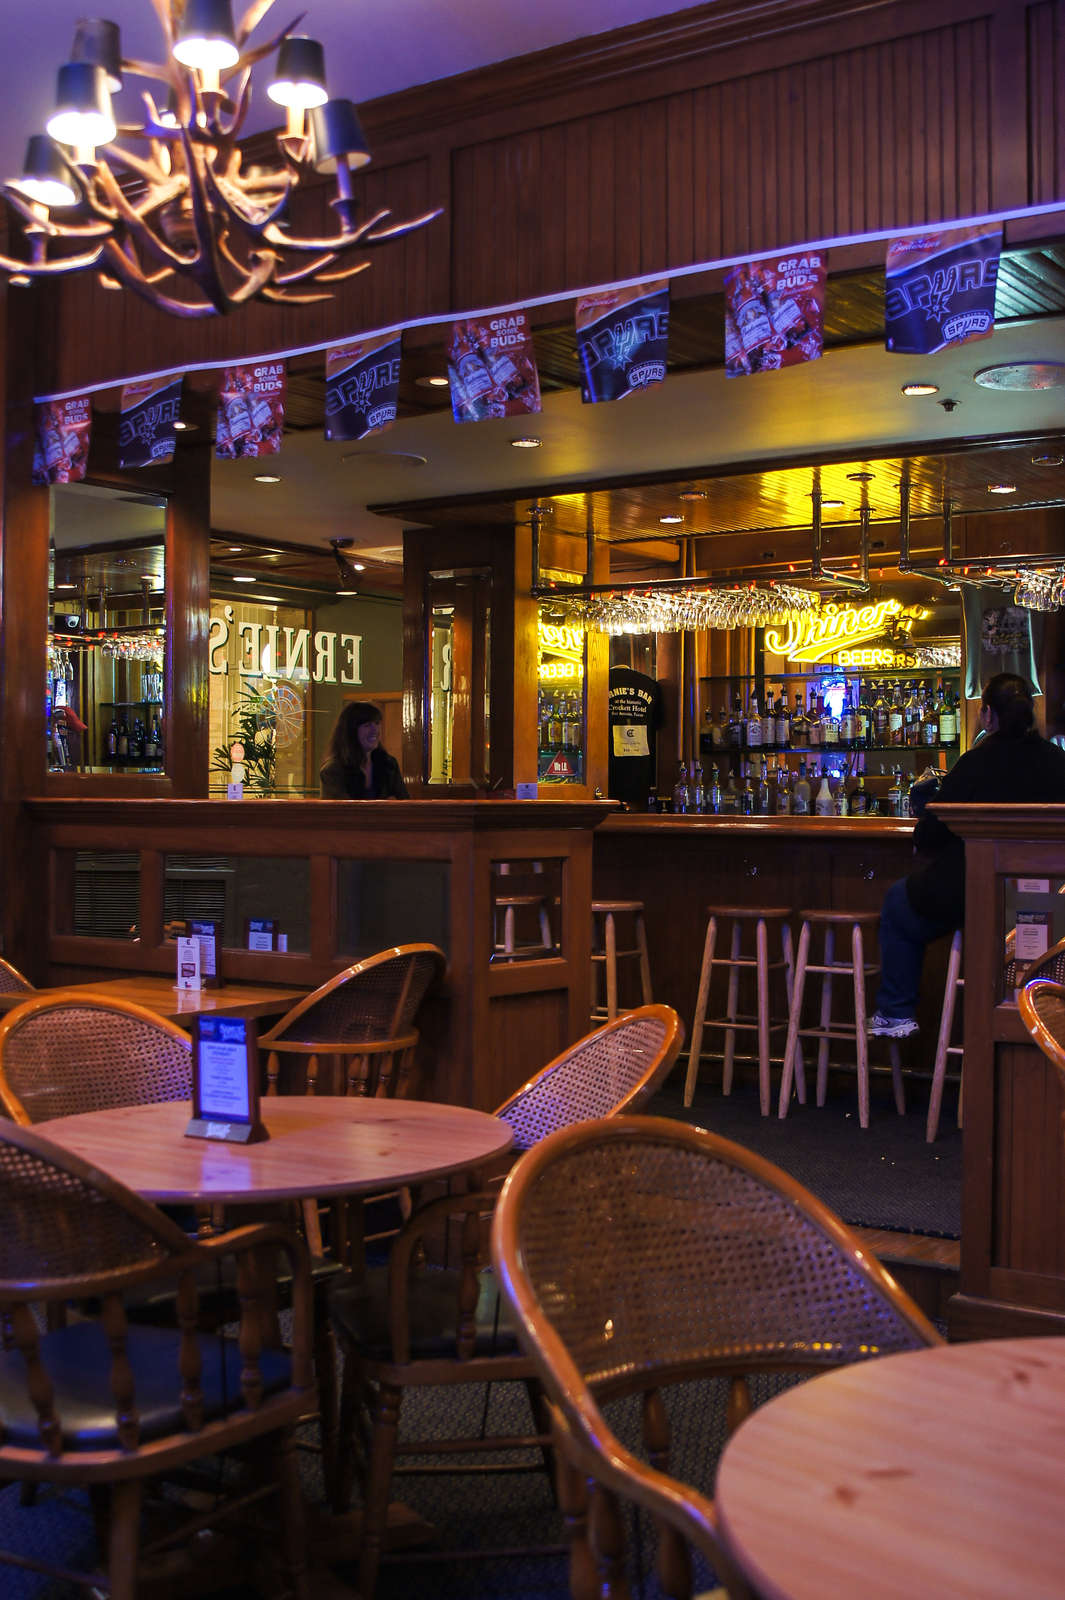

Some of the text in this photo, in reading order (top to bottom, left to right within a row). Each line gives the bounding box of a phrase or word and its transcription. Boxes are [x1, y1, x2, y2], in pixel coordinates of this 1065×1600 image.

[778, 257, 820, 272] GRAB
[776, 275, 818, 290] BUDS
[490, 315, 525, 330] GRAB
[947, 318, 987, 336] SPURS
[490, 333, 526, 347] BUDS
[254, 365, 283, 377] GRAB
[631, 367, 663, 383] SPURS
[253, 381, 283, 392] BUDS
[65, 400, 89, 410] GRAB
[64, 414, 88, 424] BUDS
[765, 598, 902, 655] Shiner
[838, 648, 895, 667] BEERS
[638, 689, 653, 704] BAR
